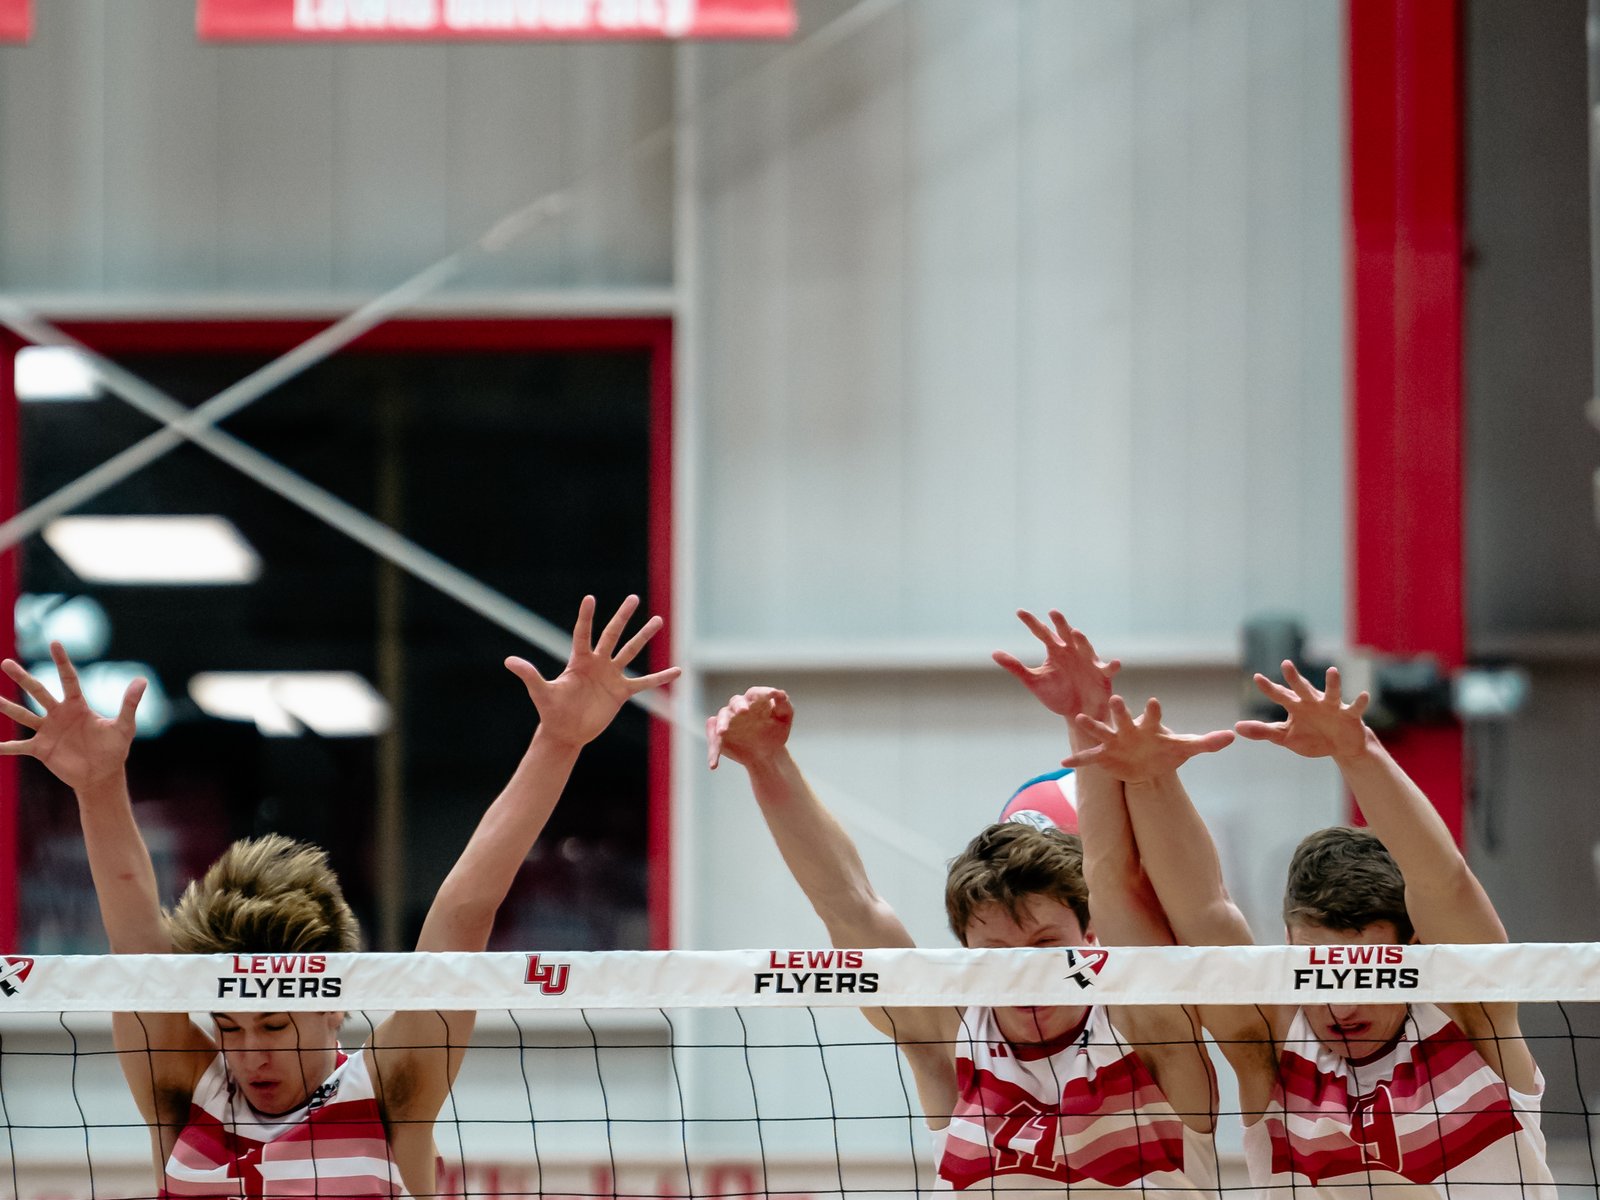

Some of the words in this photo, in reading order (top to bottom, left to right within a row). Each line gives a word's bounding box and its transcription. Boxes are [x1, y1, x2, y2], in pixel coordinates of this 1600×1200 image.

[232, 955, 327, 974] LEWIS
[769, 950, 863, 969] LEWIS
[1308, 946, 1404, 965] LEWIS
[524, 953, 571, 996] LU
[753, 973, 880, 994] FLYERS
[1293, 968, 1420, 990] FLYERS
[217, 977, 342, 999] FLYERS
